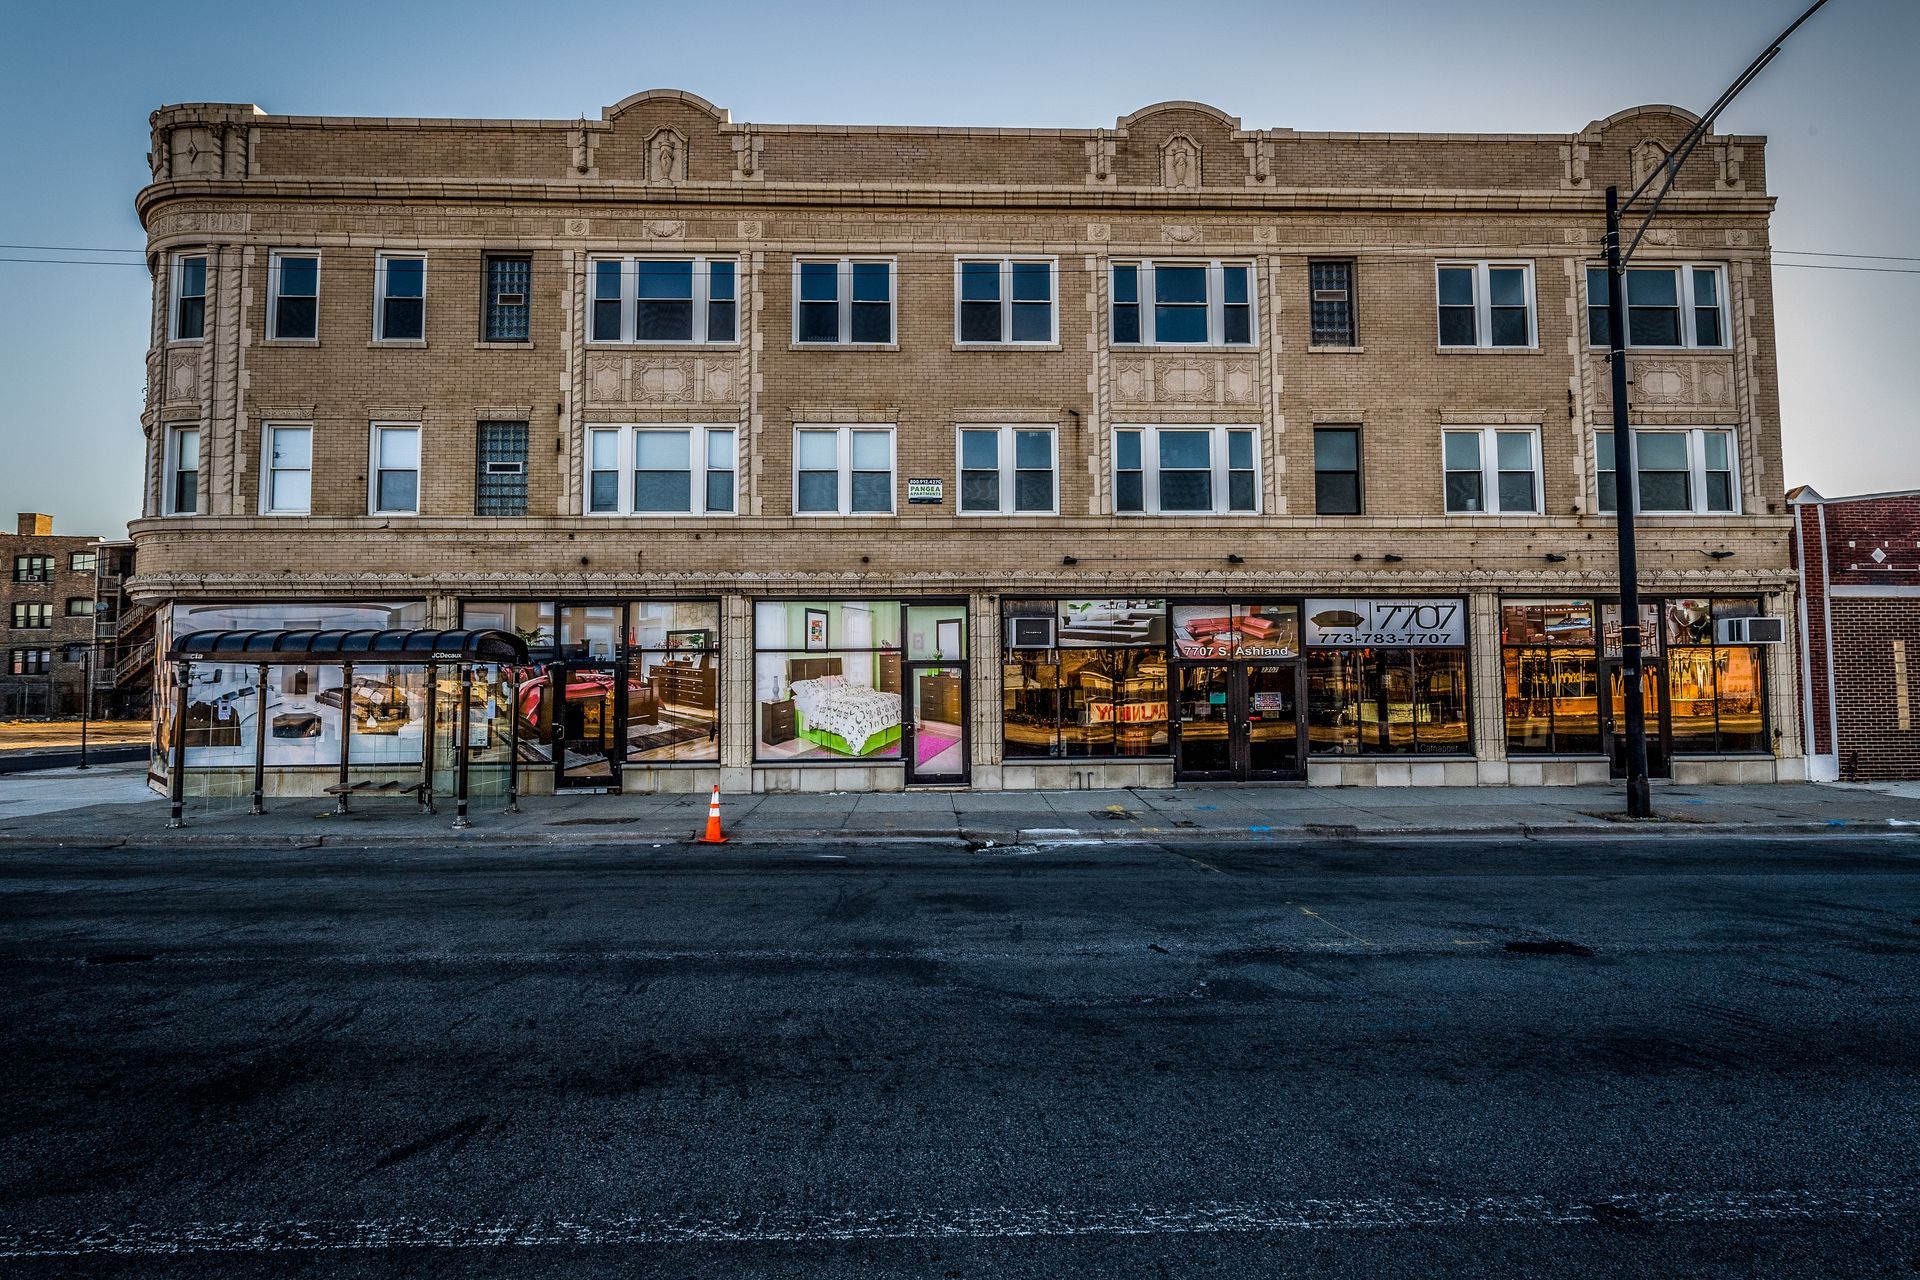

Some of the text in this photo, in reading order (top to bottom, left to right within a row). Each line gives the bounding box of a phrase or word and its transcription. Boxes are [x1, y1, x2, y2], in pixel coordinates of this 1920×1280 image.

[1376, 605, 1457, 630] 7707
[1318, 633, 1452, 644] 773-783-7707
[1184, 646, 1289, 656] 7707 S. Ashland
